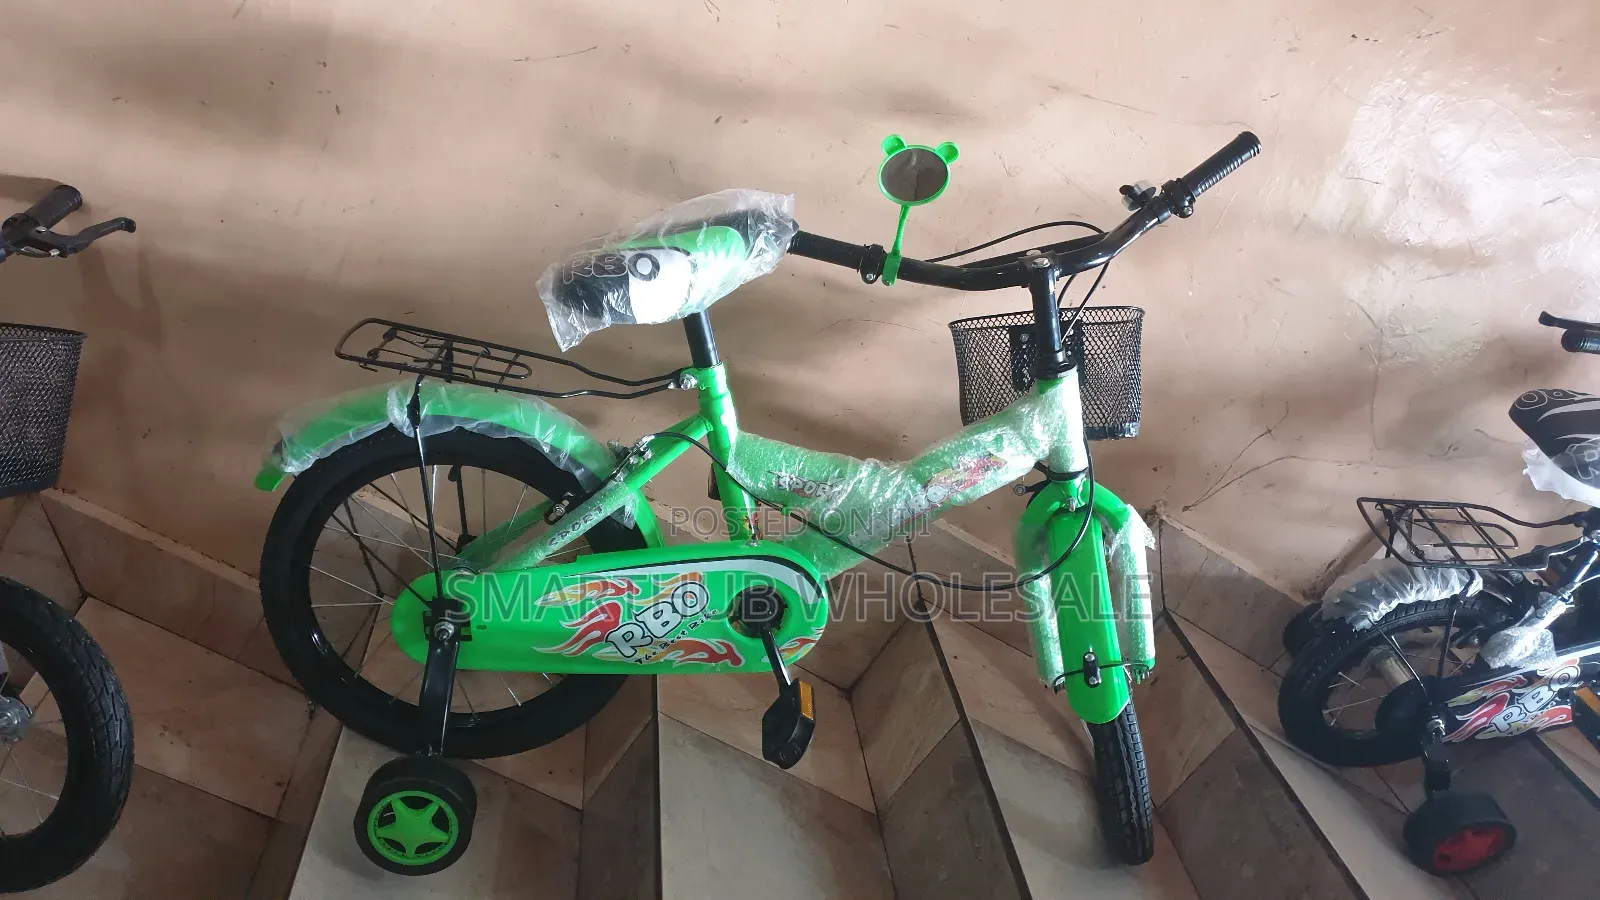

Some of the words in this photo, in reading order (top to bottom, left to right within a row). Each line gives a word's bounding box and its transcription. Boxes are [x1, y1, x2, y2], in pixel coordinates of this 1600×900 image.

[563, 253, 660, 284] RBO
[604, 581, 710, 658] RBO
[1490, 665, 1580, 734] RBO
